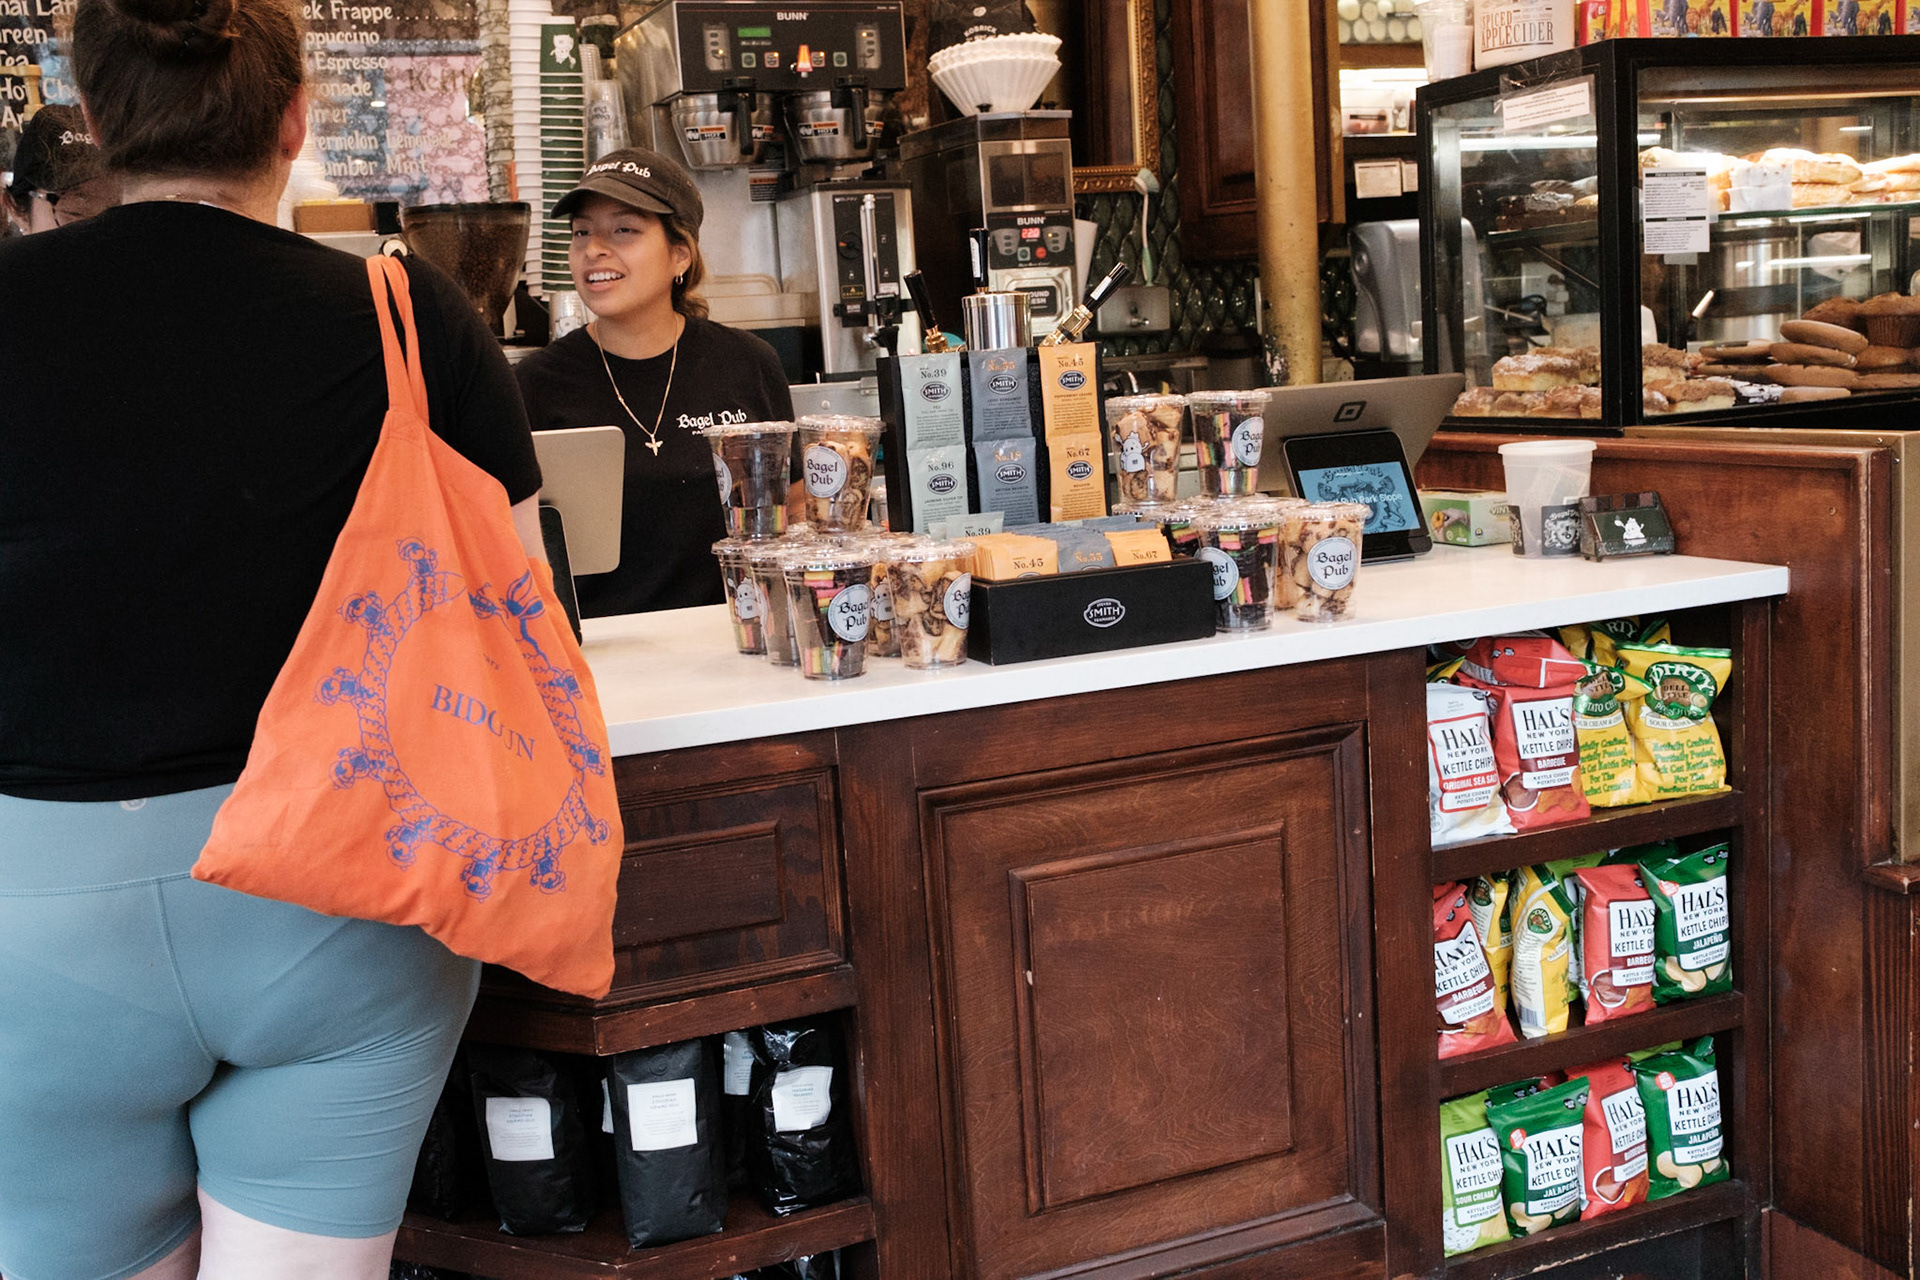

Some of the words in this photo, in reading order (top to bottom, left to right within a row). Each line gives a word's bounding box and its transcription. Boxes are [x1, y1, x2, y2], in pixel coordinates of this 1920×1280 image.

[776, 12, 808, 21] BUNN
[1482, 11, 1512, 29] SPICED
[0, 27, 48, 44] reen
[963, 25, 997, 37] KOBRICK
[1482, 25, 1512, 49] APPLE
[1512, 21, 1554, 43] CIDER
[314, 51, 389, 75] Espresso
[385, 129, 458, 149] Lemonade
[385, 154, 430, 174] Mint
[623, 162, 652, 178] Pub
[1017, 217, 1046, 226] BUNN
[1058, 357, 1084, 368] No.45
[920, 368, 947, 379] No.39
[1062, 376, 1083, 385] SMITH
[924, 387, 947, 396] SMITH
[991, 380, 1015, 388] SMITH
[676, 411, 714, 430] Bagel
[718, 409, 747, 426] Pub
[1066, 448, 1090, 458] No.67
[806, 458, 838, 474] Bagel
[928, 461, 954, 472] No.96
[1070, 466, 1090, 475] SMITH
[809, 473, 834, 486] Pub
[999, 470, 1022, 479] SMITH
[931, 479, 954, 488] SMITH
[1359, 494, 1378, 504] Park
[1379, 493, 1403, 504] Slope
[965, 527, 991, 538] No.39
[1075, 552, 1103, 563] No.55
[1133, 550, 1158, 560] No.67
[1315, 550, 1353, 564] Bagel
[1013, 558, 1044, 570] No.45
[1321, 565, 1349, 579] Pub
[1089, 606, 1120, 619] SMITH
[843, 615, 867, 630] Pub
[1522, 706, 1570, 731] HAL'S
[1441, 723, 1486, 751] HAL'S
[1526, 731, 1545, 739] NEW
[1549, 728, 1570, 737] YORK
[1447, 750, 1467, 759] NEW
[1470, 746, 1488, 755] YORK
[1522, 741, 1555, 755] KETTLE
[1556, 738, 1573, 751] CHIPS
[1442, 759, 1473, 775] KETTLE
[1443, 779, 1473, 790] ORIGINAL
[1473, 776, 1486, 785] SEA
[1674, 774, 1688, 784] For
[1682, 886, 1725, 914] HAL'S
[1683, 913, 1700, 922] NEW
[1703, 906, 1724, 916] YORK
[1620, 929, 1638, 938] NEW
[1680, 920, 1707, 938] KETTLE
[1614, 938, 1645, 953] KETTLE
[1692, 933, 1724, 950] JALAPEÑO
[1437, 964, 1458, 977] NEW
[1461, 953, 1479, 966] YORK
[1435, 971, 1470, 993] KETTLE
[1469, 961, 1488, 978] CHIPS
[1677, 1081, 1718, 1108] HAL'S
[1607, 1096, 1645, 1125] HAL'S
[1679, 1107, 1700, 1116] NEW
[1703, 1101, 1718, 1111] YORK
[1614, 1124, 1628, 1133] NEW
[1674, 1115, 1706, 1131] KETTLE
[1614, 1132, 1636, 1149] KETTLE
[1688, 1127, 1719, 1145] JALAPEÑO
[1455, 1137, 1499, 1165] HAL'S
[1528, 1134, 1580, 1163] HAL'S
[1459, 1164, 1477, 1174] NEW
[1479, 1158, 1501, 1168] YORK
[1535, 1160, 1552, 1171] NEW
[1455, 1173, 1487, 1190] KETTLE
[1531, 1171, 1562, 1187] KETTLE
[1455, 1195, 1473, 1206] SOUR
[1473, 1189, 1494, 1201] CREAM
